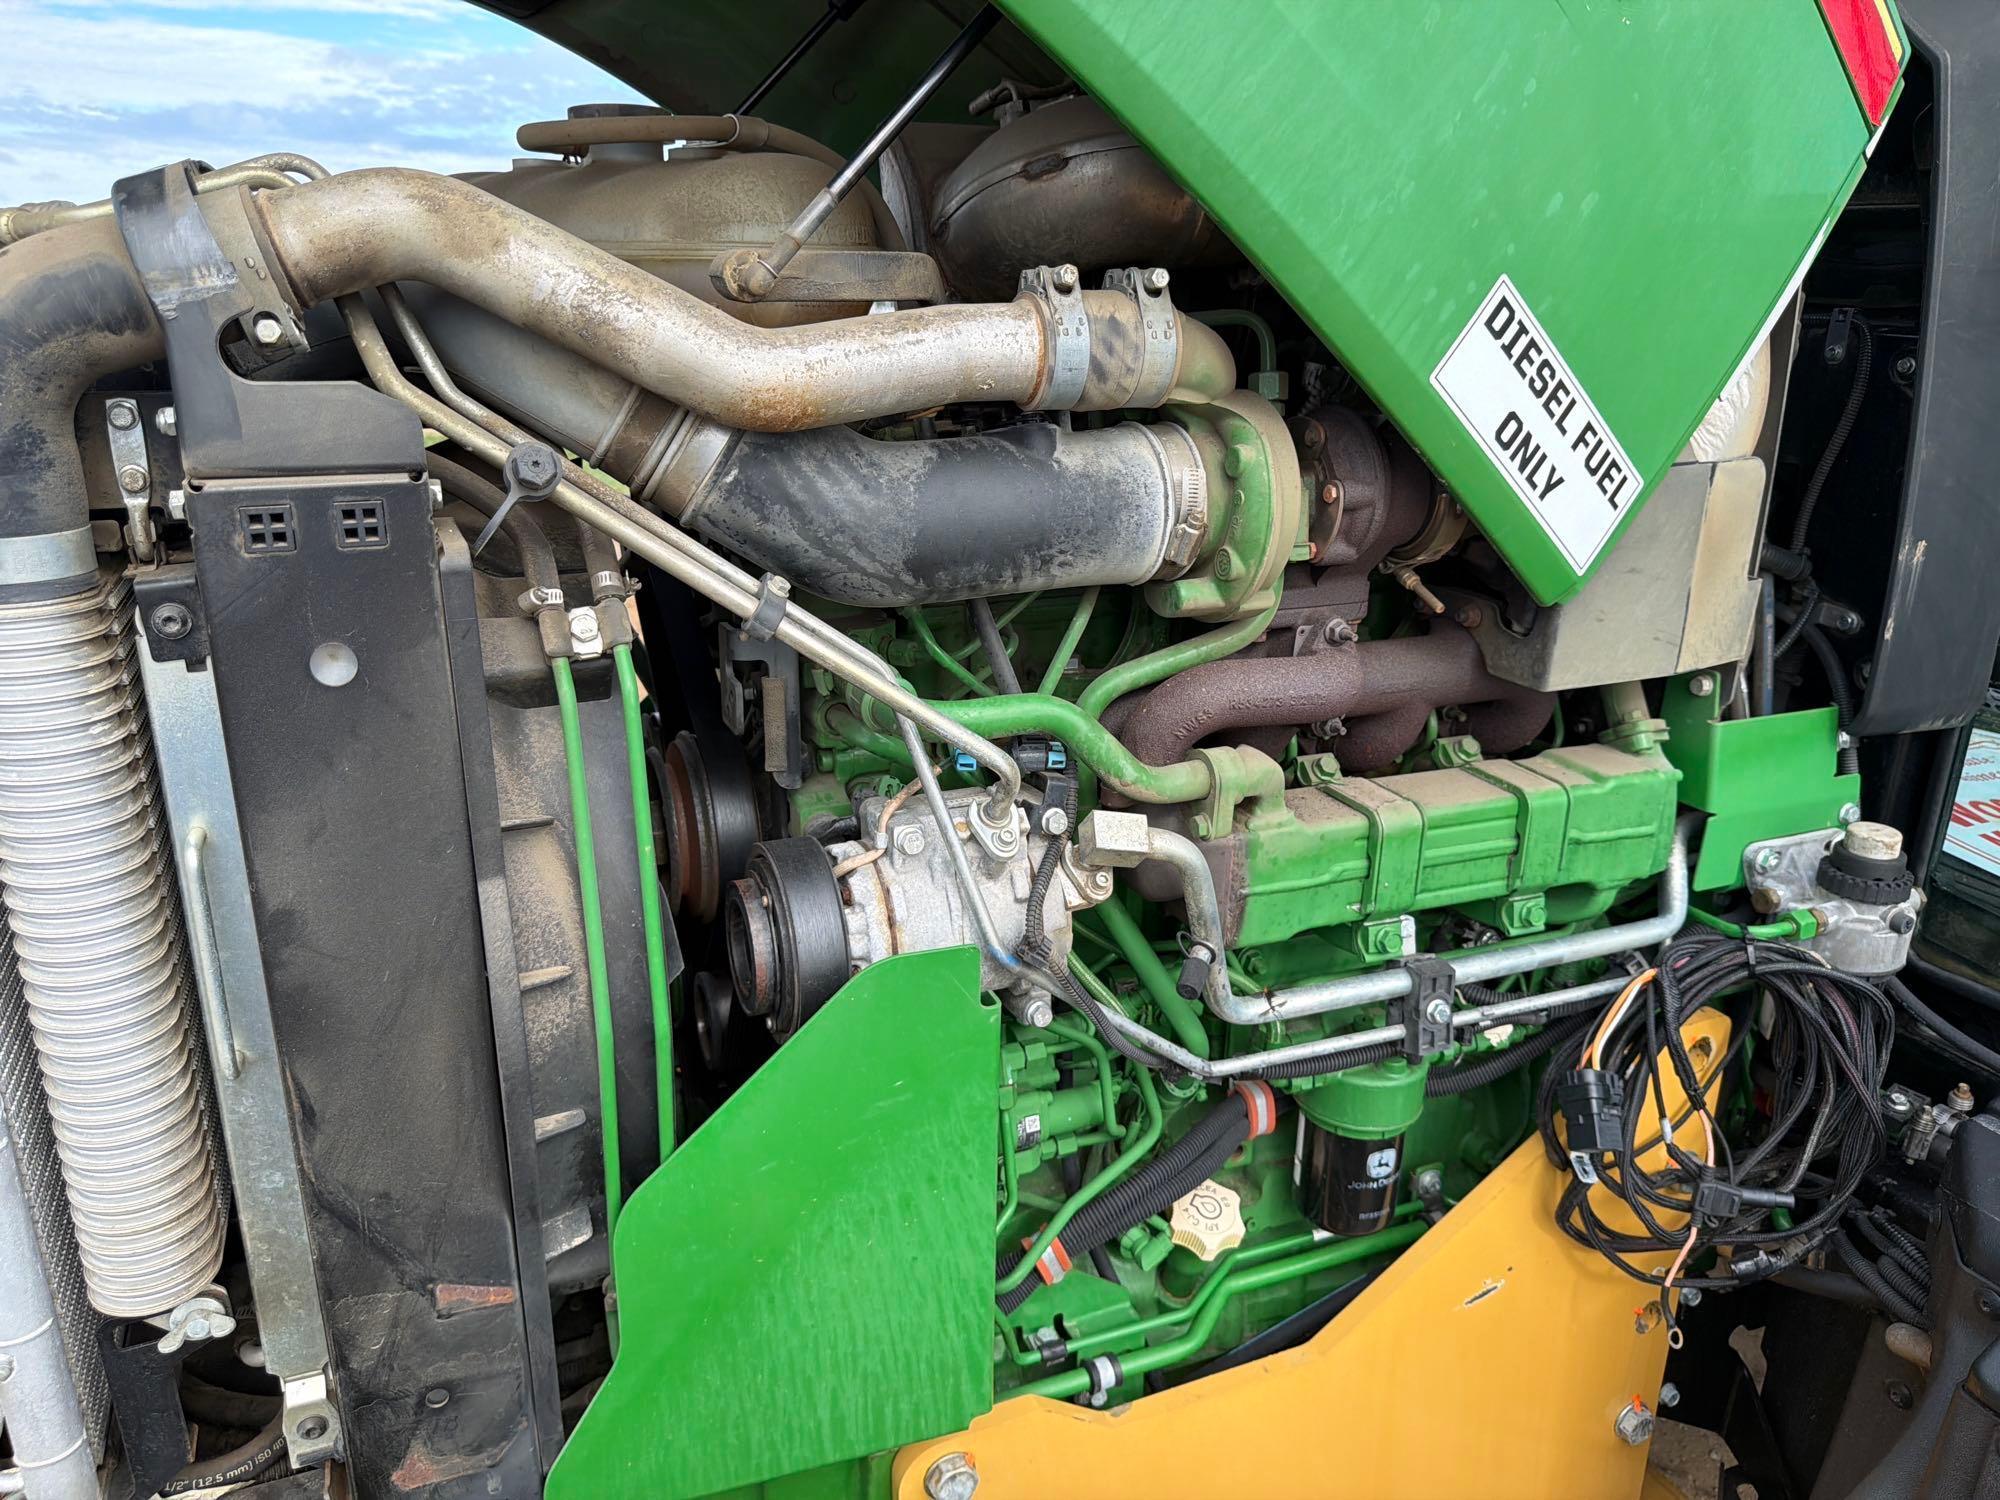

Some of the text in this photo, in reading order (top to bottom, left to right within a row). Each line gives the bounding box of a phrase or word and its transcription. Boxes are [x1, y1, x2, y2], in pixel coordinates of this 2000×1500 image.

[1484, 295, 1629, 511] DIESEL FUEL
[1495, 411, 1565, 501] ONLY
[1195, 1184, 1217, 1194] CEA
[1347, 1181, 1377, 1190] JOHN
[255, 1449, 272, 1465] ISO
